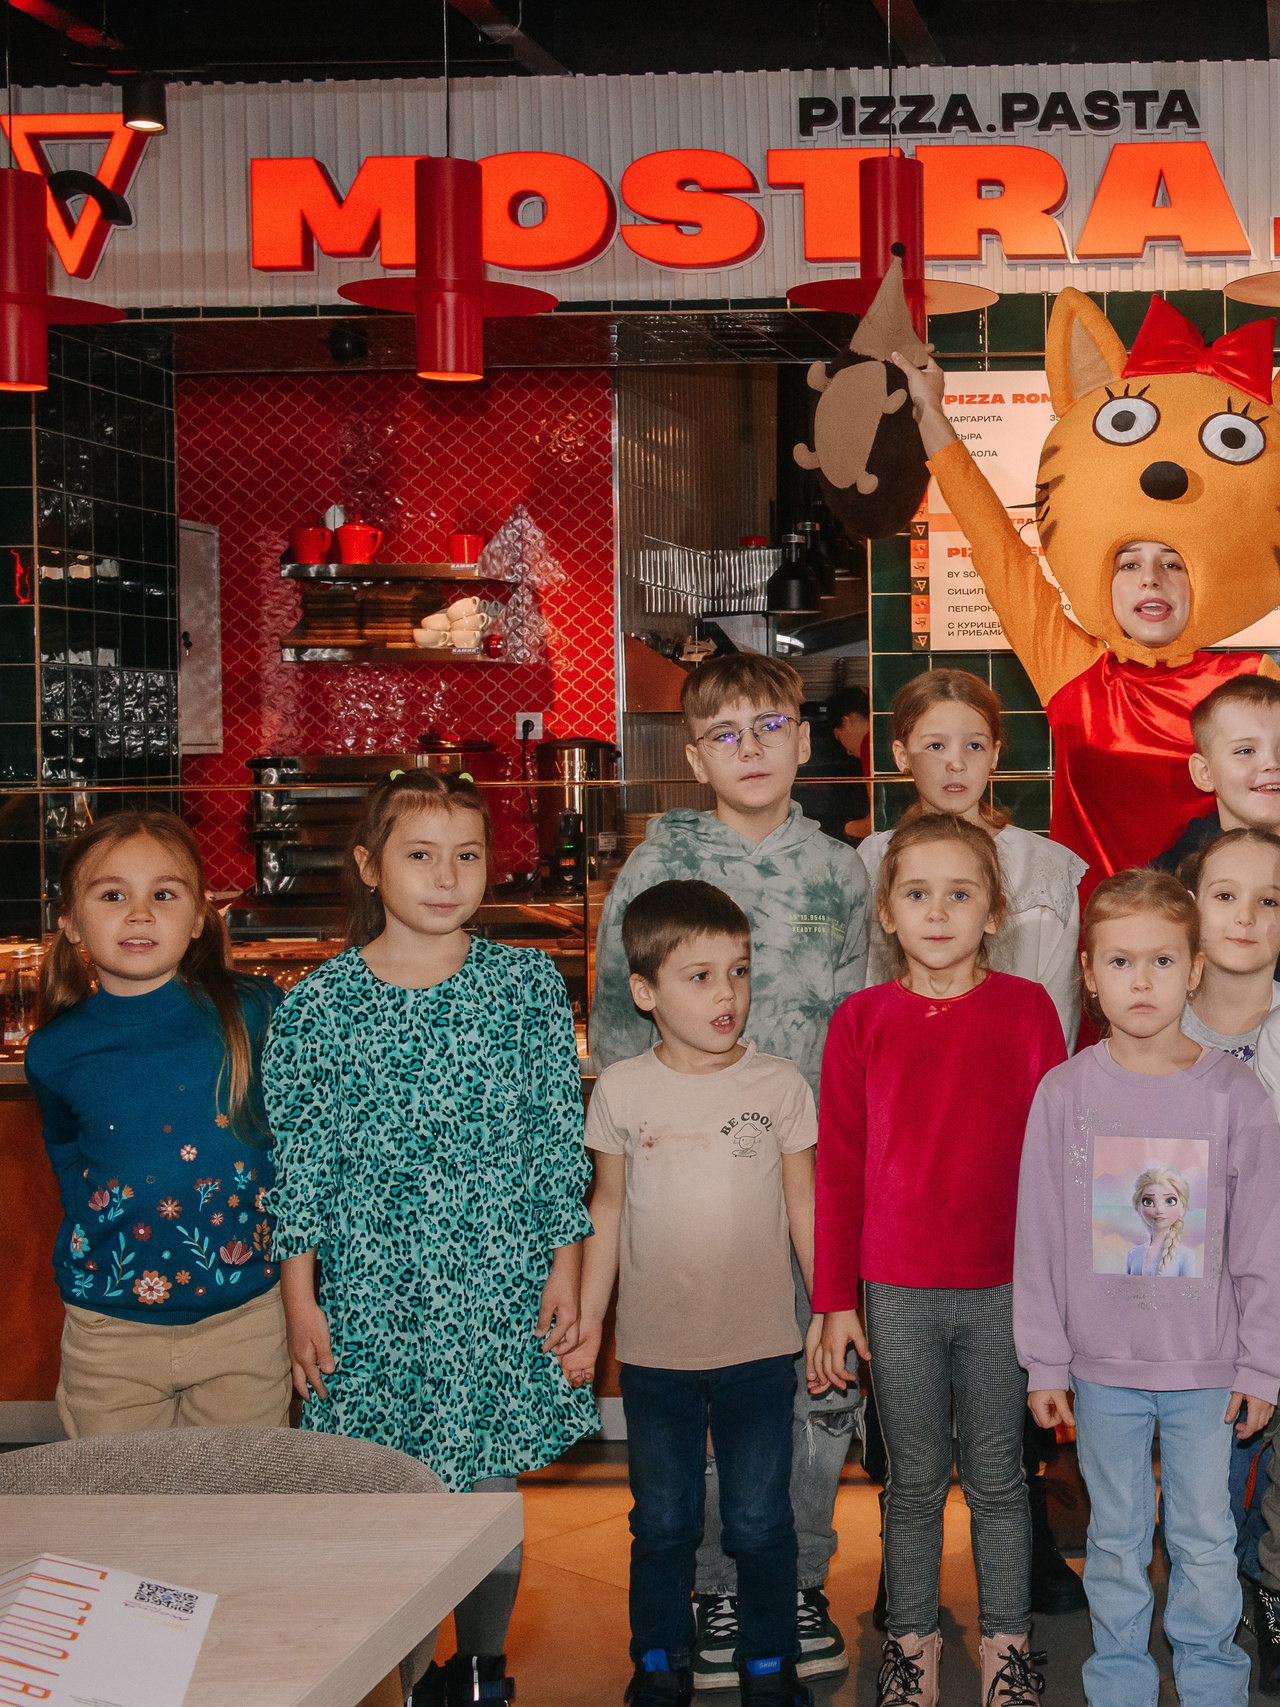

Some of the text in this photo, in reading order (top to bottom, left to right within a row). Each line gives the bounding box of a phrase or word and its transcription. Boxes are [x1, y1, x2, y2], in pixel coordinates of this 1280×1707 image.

[799, 89, 1201, 136] PIZZA.PASTA
[251, 140, 1252, 272] MOSTRA
[944, 393, 1006, 405] PIZZA
[719, 1112, 773, 1136] BE COOL
